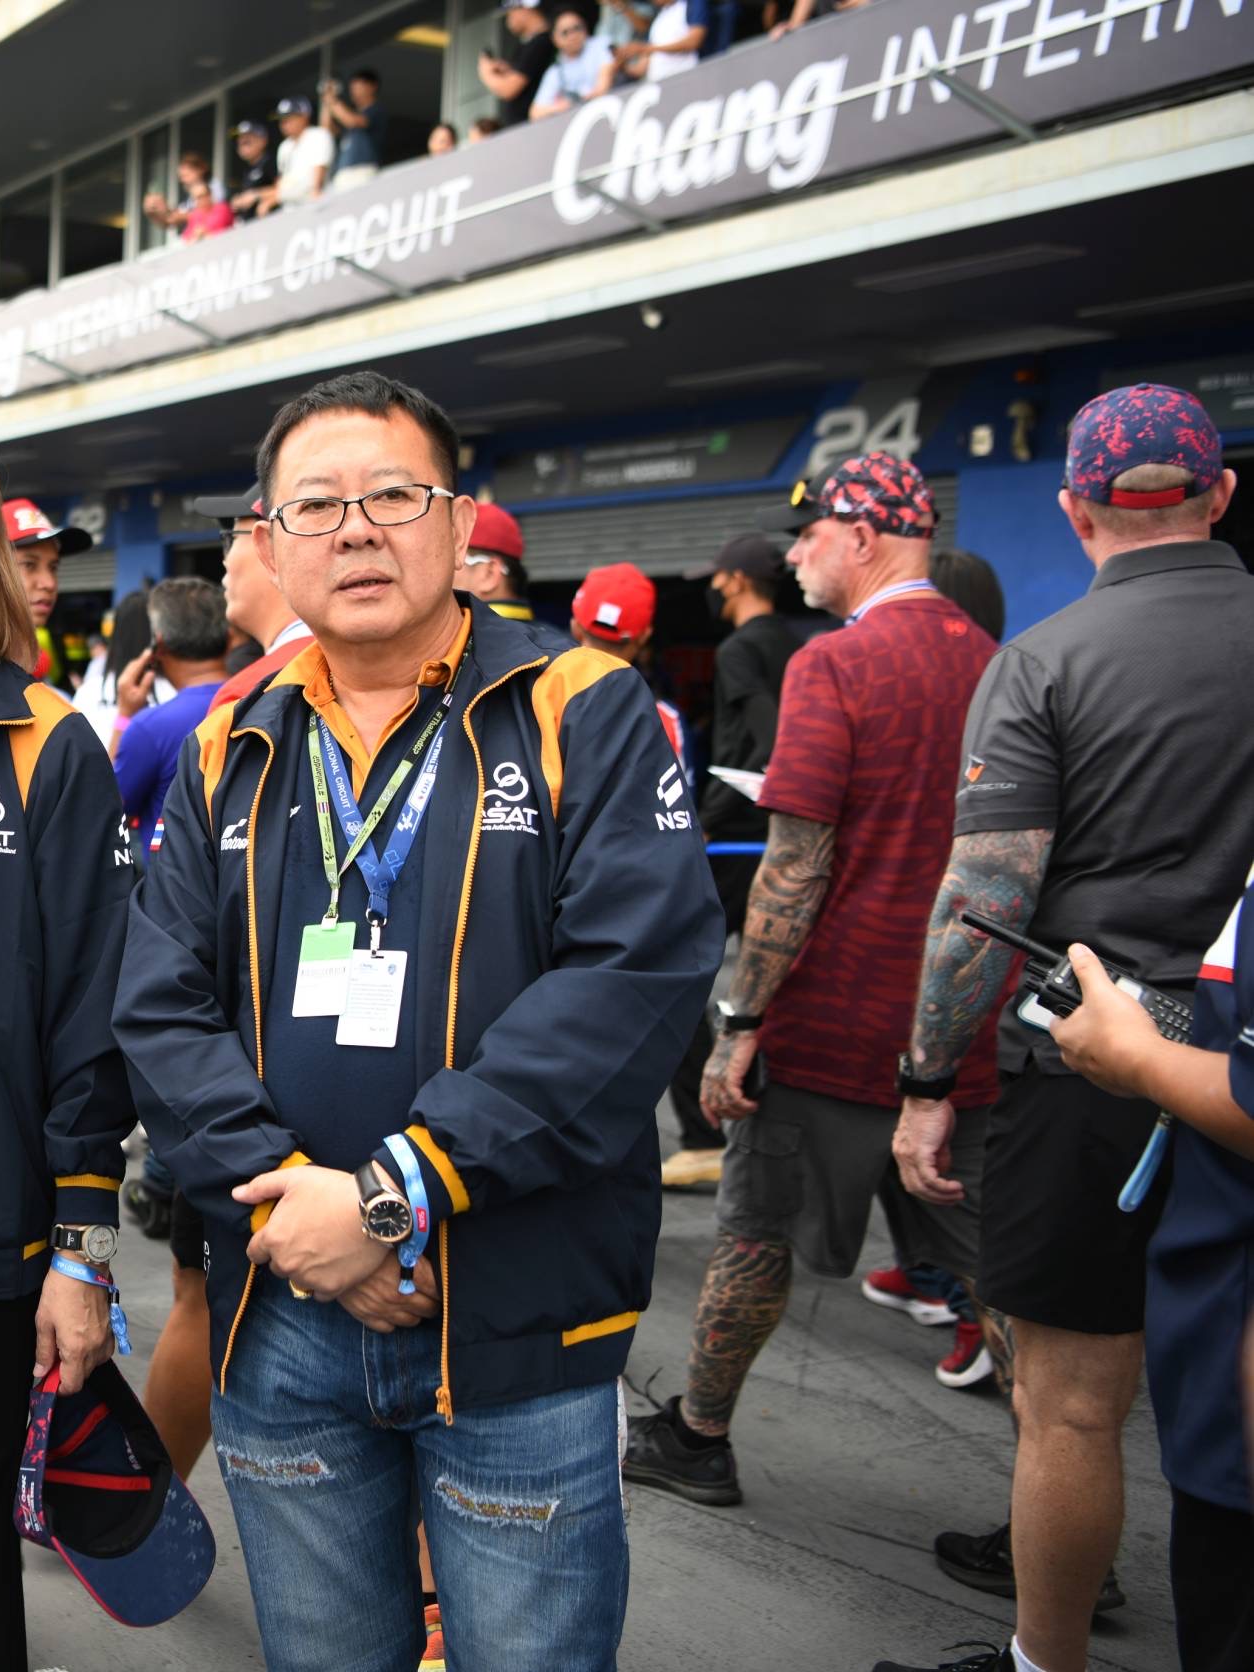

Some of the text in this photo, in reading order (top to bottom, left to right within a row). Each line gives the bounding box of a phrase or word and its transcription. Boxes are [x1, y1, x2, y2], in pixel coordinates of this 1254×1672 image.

[551, 53, 850, 226] Chang
[282, 175, 474, 293] CIRCUIT
[808, 399, 922, 478] 24
[335, 776, 351, 809] CIRCUIT
[482, 806, 538, 826] SAT
